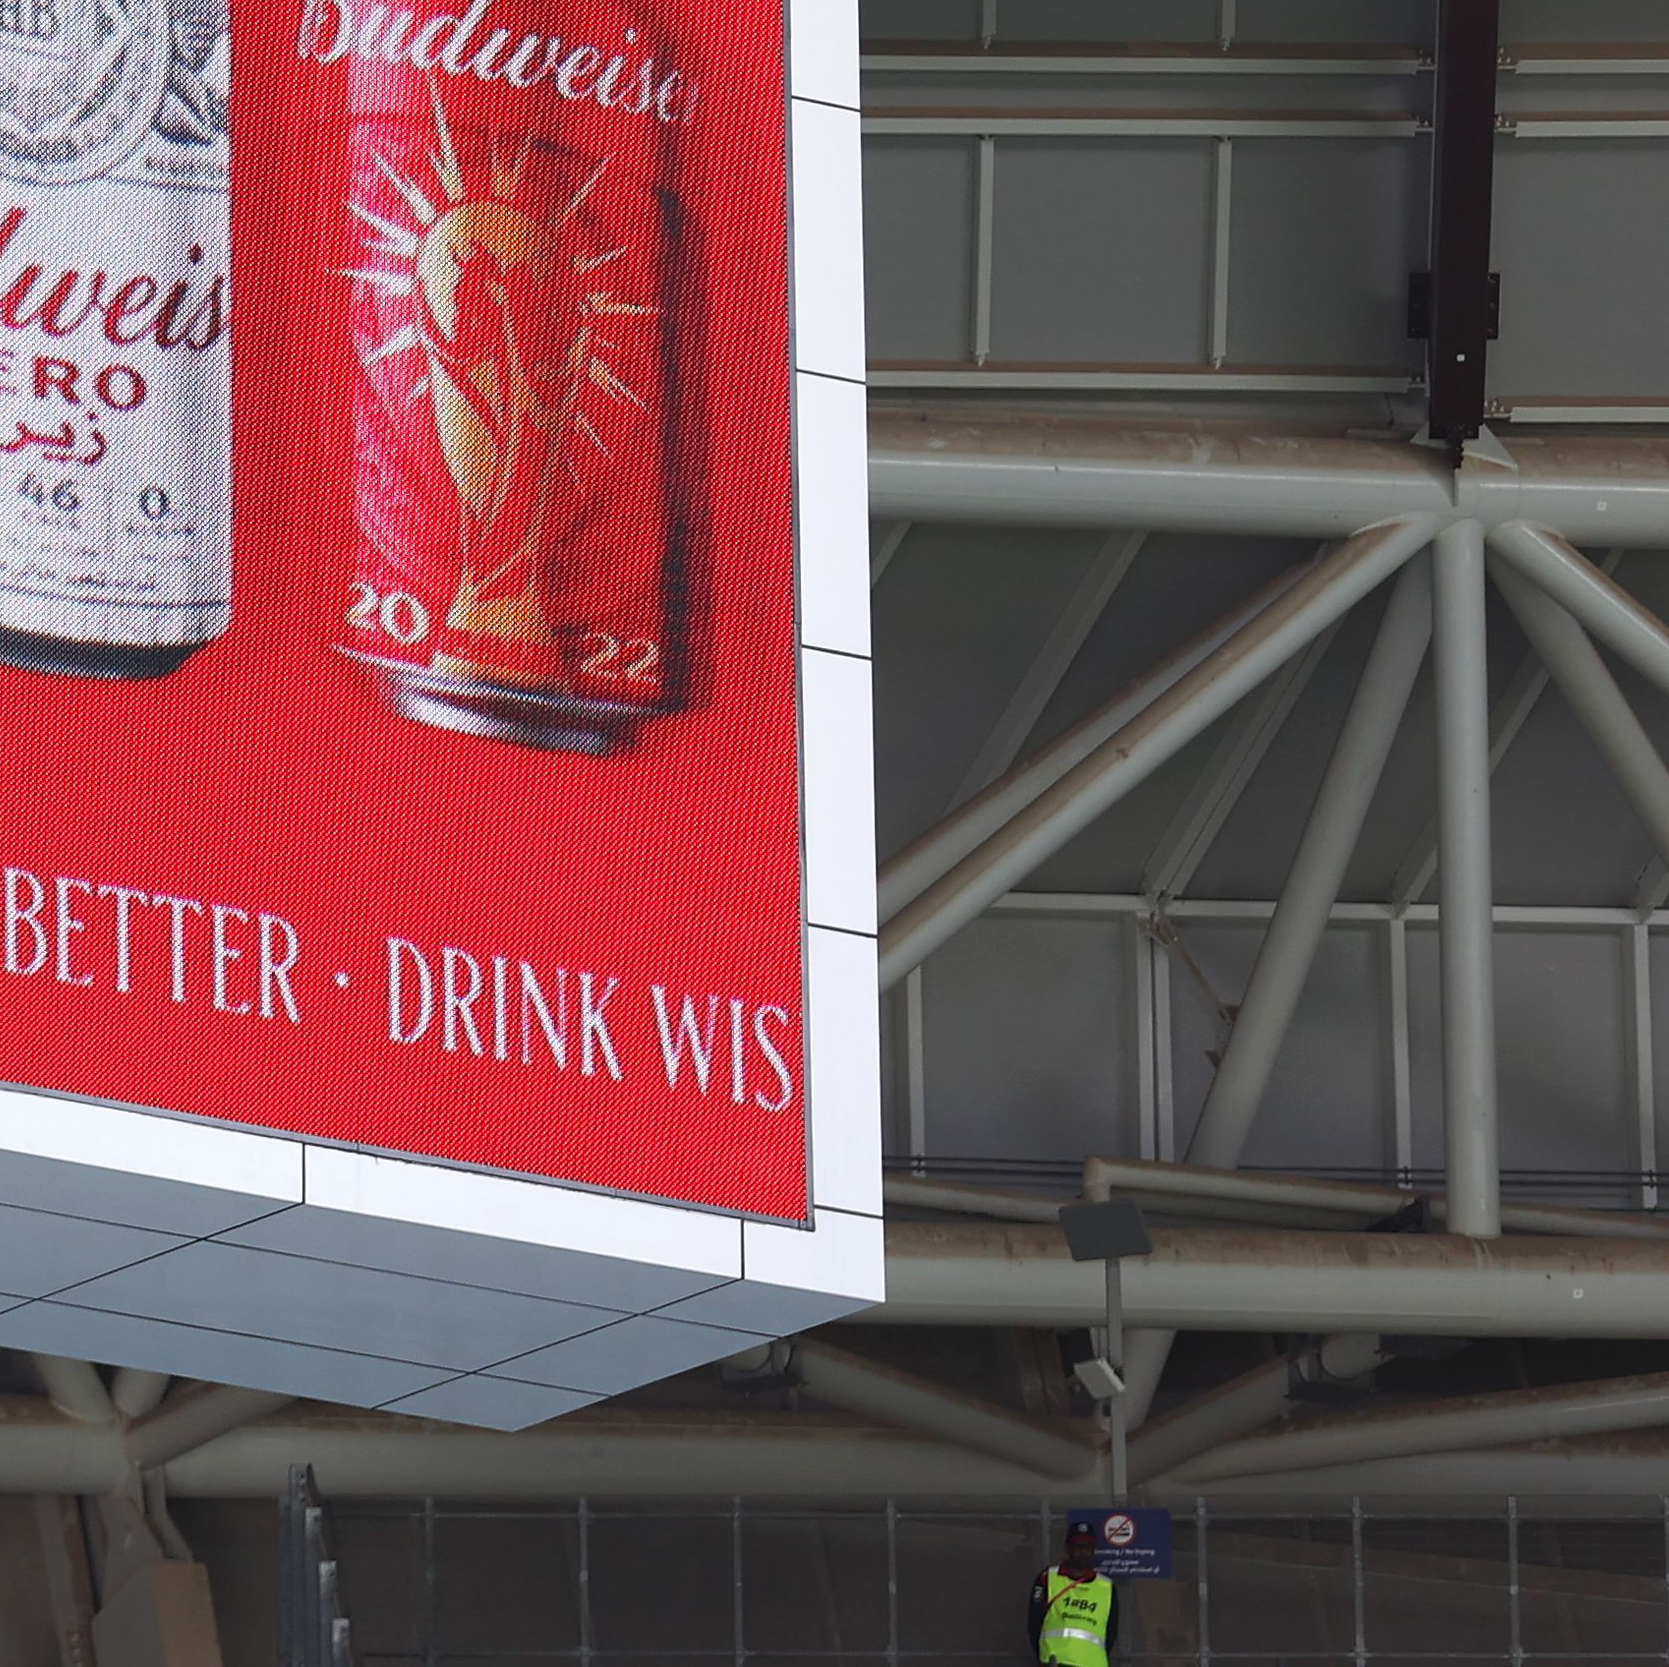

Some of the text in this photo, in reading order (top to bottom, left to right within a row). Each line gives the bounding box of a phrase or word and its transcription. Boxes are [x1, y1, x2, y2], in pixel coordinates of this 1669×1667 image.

[17, 471, 83, 513] 46
[344, 579, 660, 684] 20 22
[2, 865, 301, 1024] BETTER
[386, 936, 624, 1082] DRINK
[649, 983, 794, 1115] WIS
